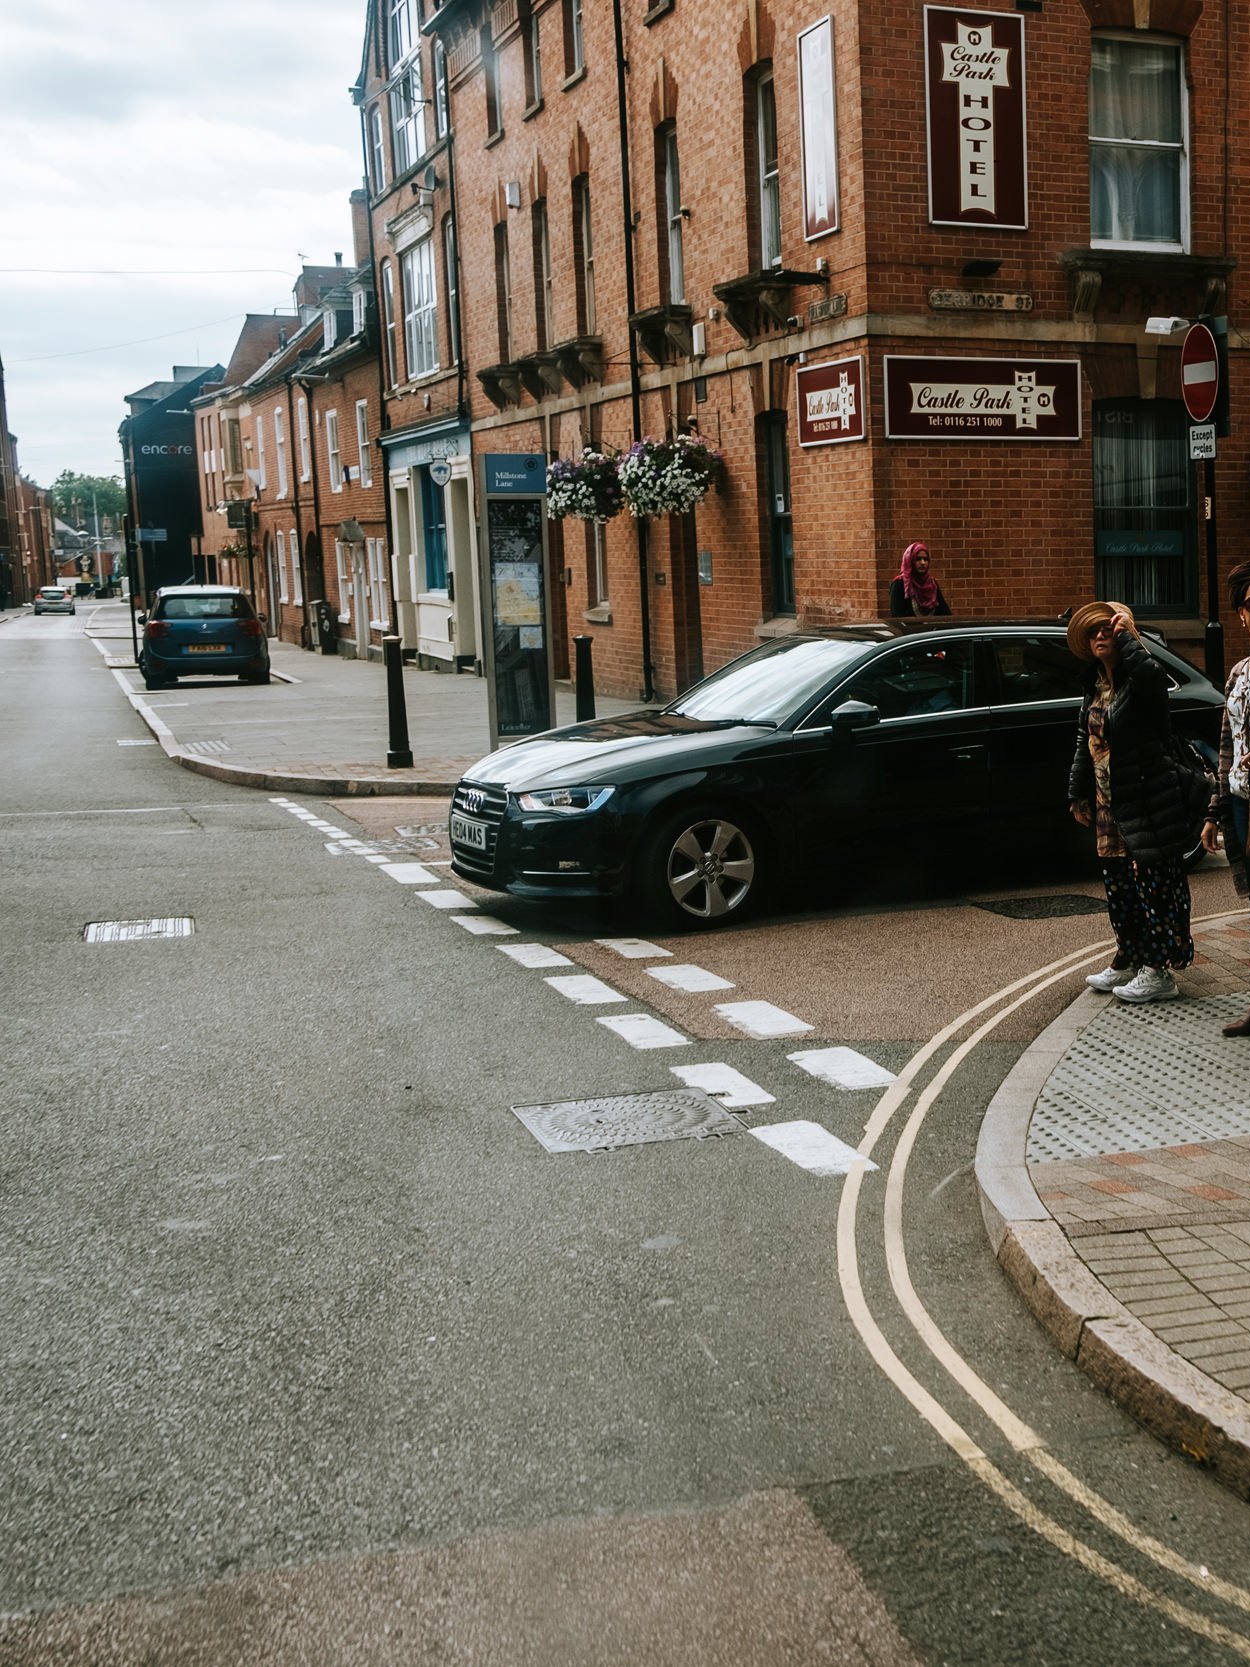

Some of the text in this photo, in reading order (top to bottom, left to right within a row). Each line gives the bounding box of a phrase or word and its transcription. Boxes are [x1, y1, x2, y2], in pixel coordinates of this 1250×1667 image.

[950, 45, 1001, 65] Castle
[949, 62, 996, 81] Park
[961, 94, 992, 197] HOTEL
[840, 376, 848, 426] HOTEL
[917, 386, 1014, 410] Castle Park
[1016, 375, 1034, 425] HOTEL
[928, 416, 1003, 426] Tel: 0116 251 1000
[1191, 429, 1213, 441] Except
[141, 444, 193, 455] encore
[495, 471, 527, 479] Millstone
[495, 479, 513, 487] Lane
